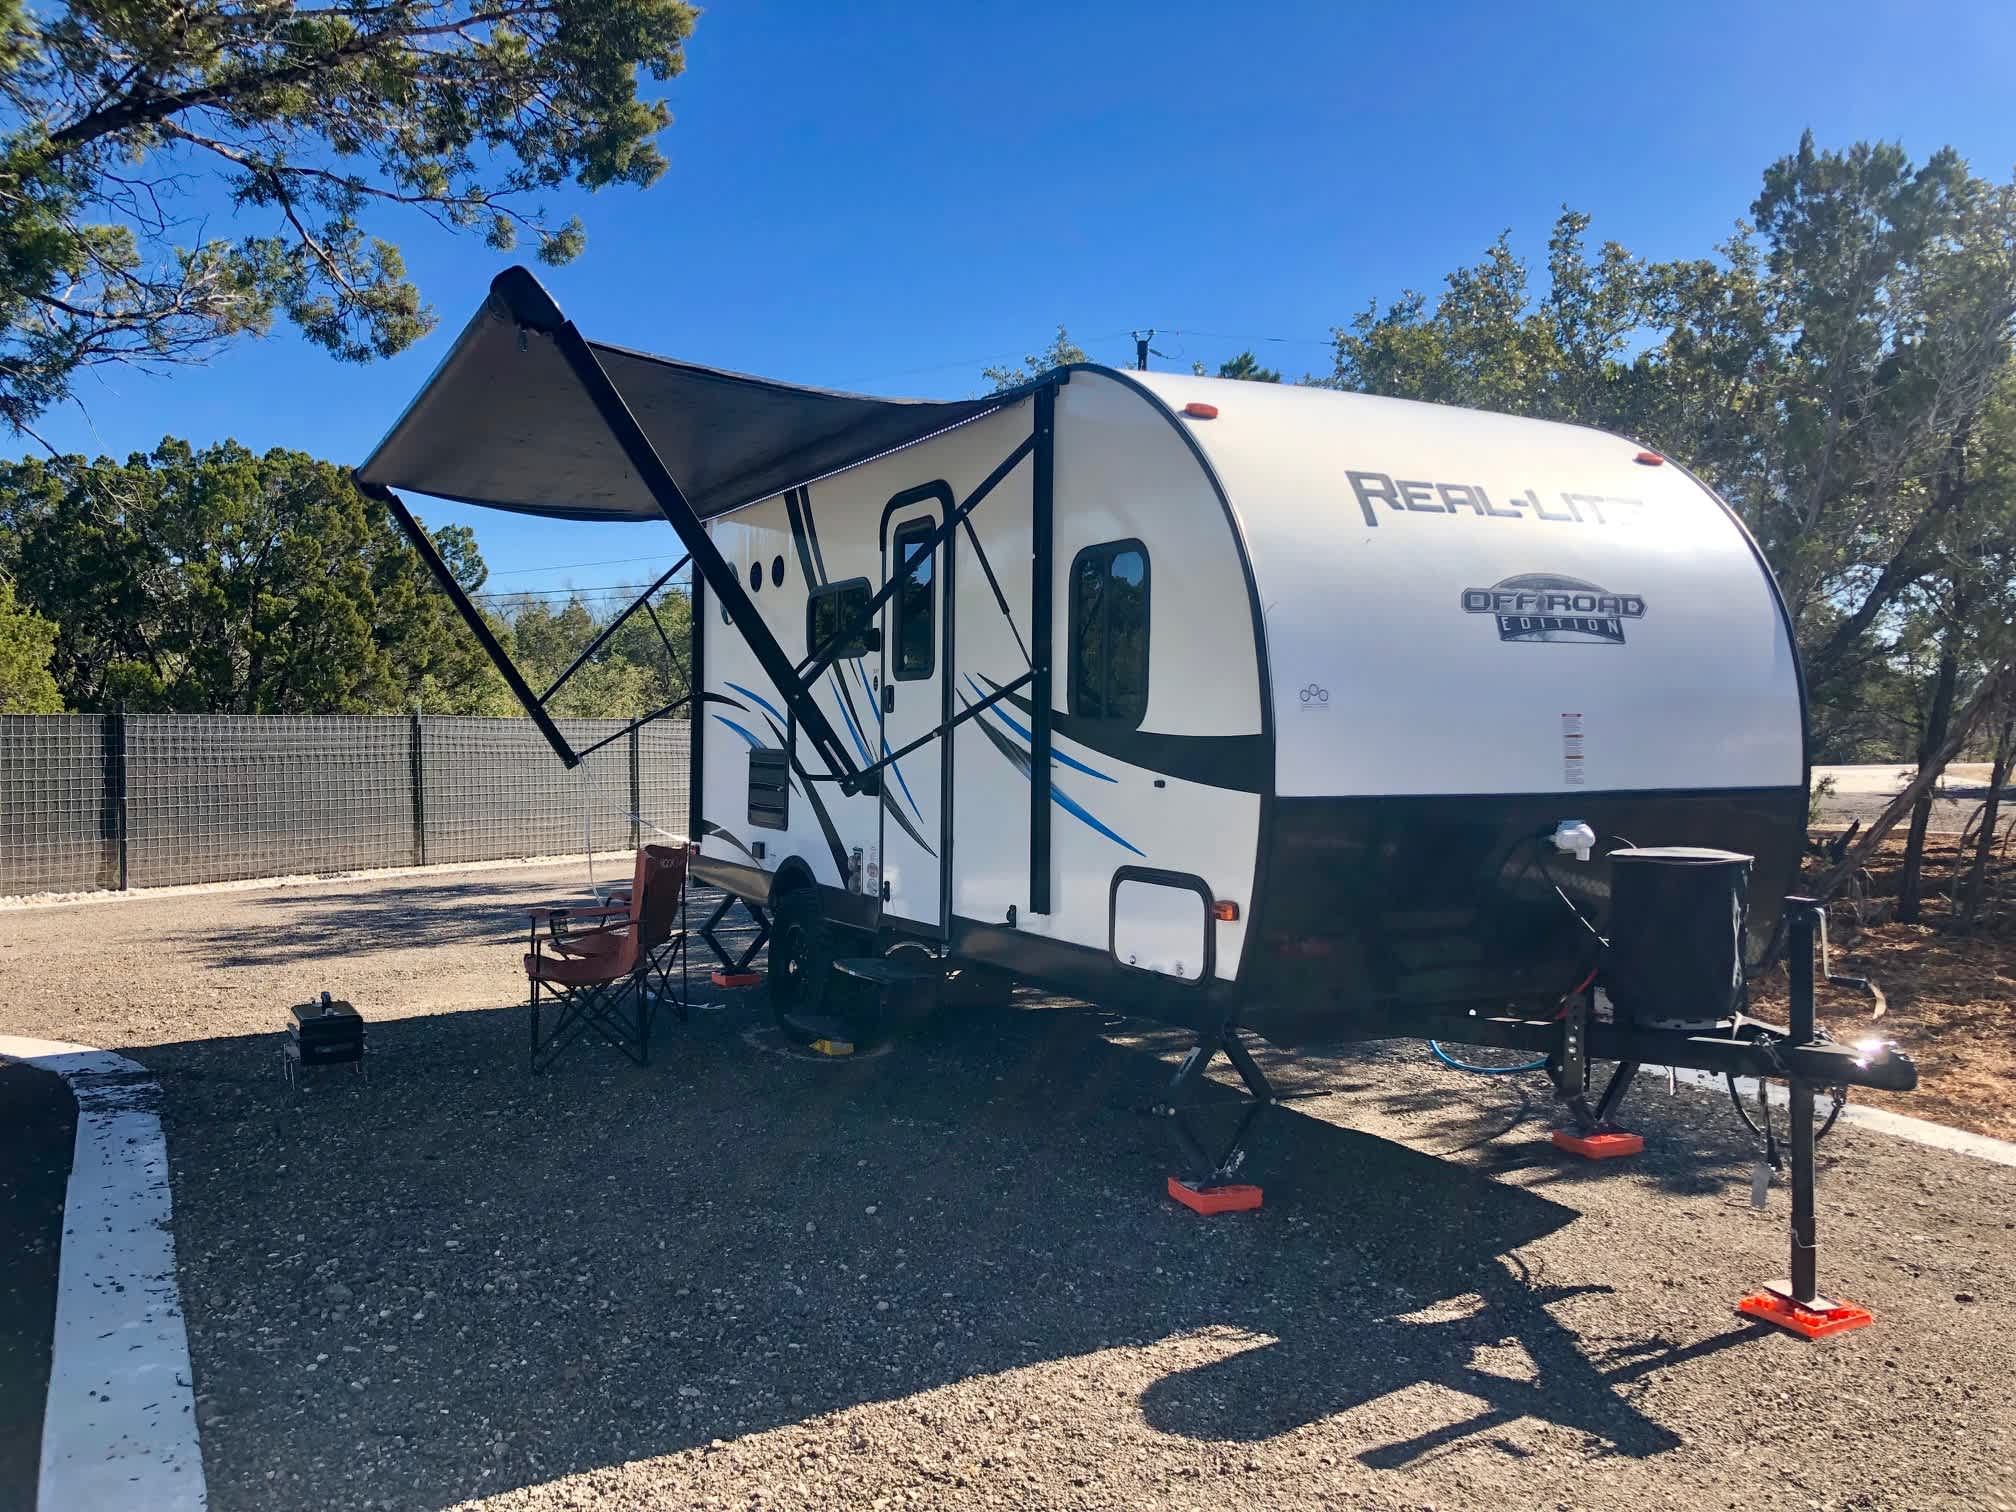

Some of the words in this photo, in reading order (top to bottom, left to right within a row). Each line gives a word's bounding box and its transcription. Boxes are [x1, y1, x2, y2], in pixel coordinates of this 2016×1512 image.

[1463, 590, 1541, 612] OFF
[1547, 593, 1648, 617] ROAD
[1501, 616, 1620, 634] EDITION
